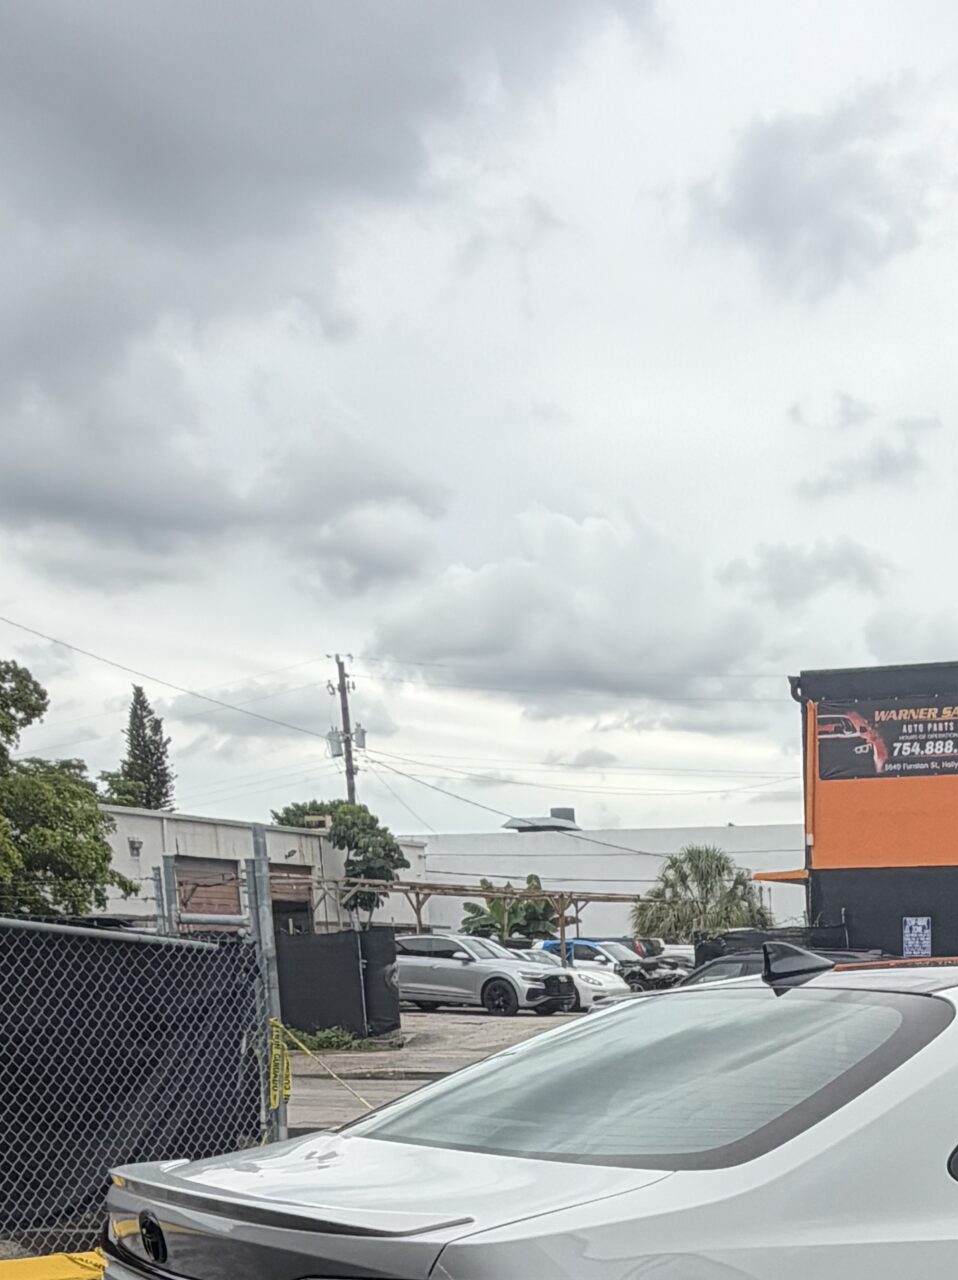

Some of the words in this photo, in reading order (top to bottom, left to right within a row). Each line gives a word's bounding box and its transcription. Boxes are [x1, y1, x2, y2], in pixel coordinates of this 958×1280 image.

[874, 707, 938, 721] WARNER
[902, 723, 924, 733] AUTO
[928, 721, 954, 732] PARTS
